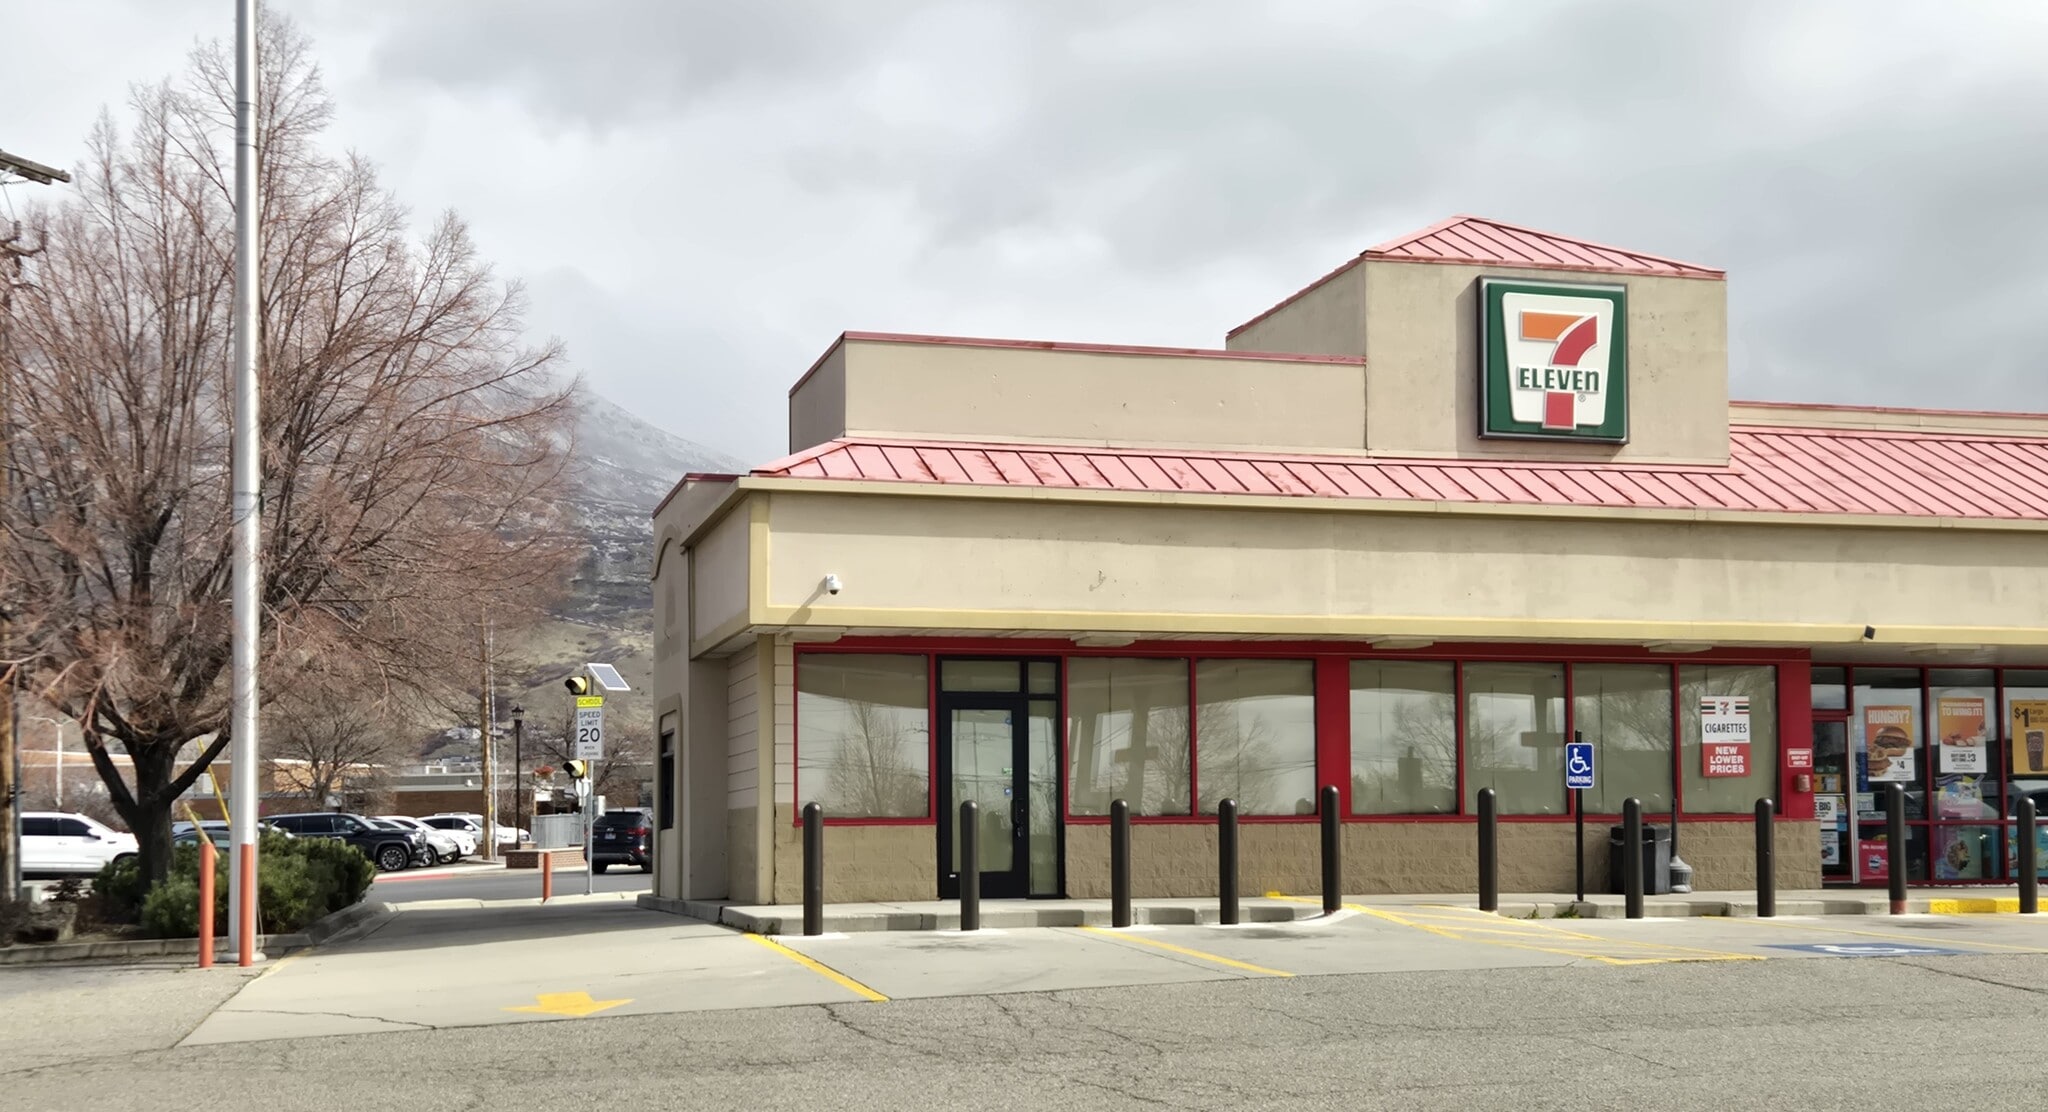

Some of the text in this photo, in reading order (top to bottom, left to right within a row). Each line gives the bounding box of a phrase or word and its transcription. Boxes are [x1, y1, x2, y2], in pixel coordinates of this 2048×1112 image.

[1522, 311, 1598, 427] 7
[1868, 709, 1910, 724] HUNGRY?
[1705, 723, 1747, 733] CIGARETTES
[579, 728, 600, 742] 20
[1715, 746, 1738, 754] NEW
[1710, 755, 1743, 763] LOWER
[1710, 764, 1744, 773] PRICES
